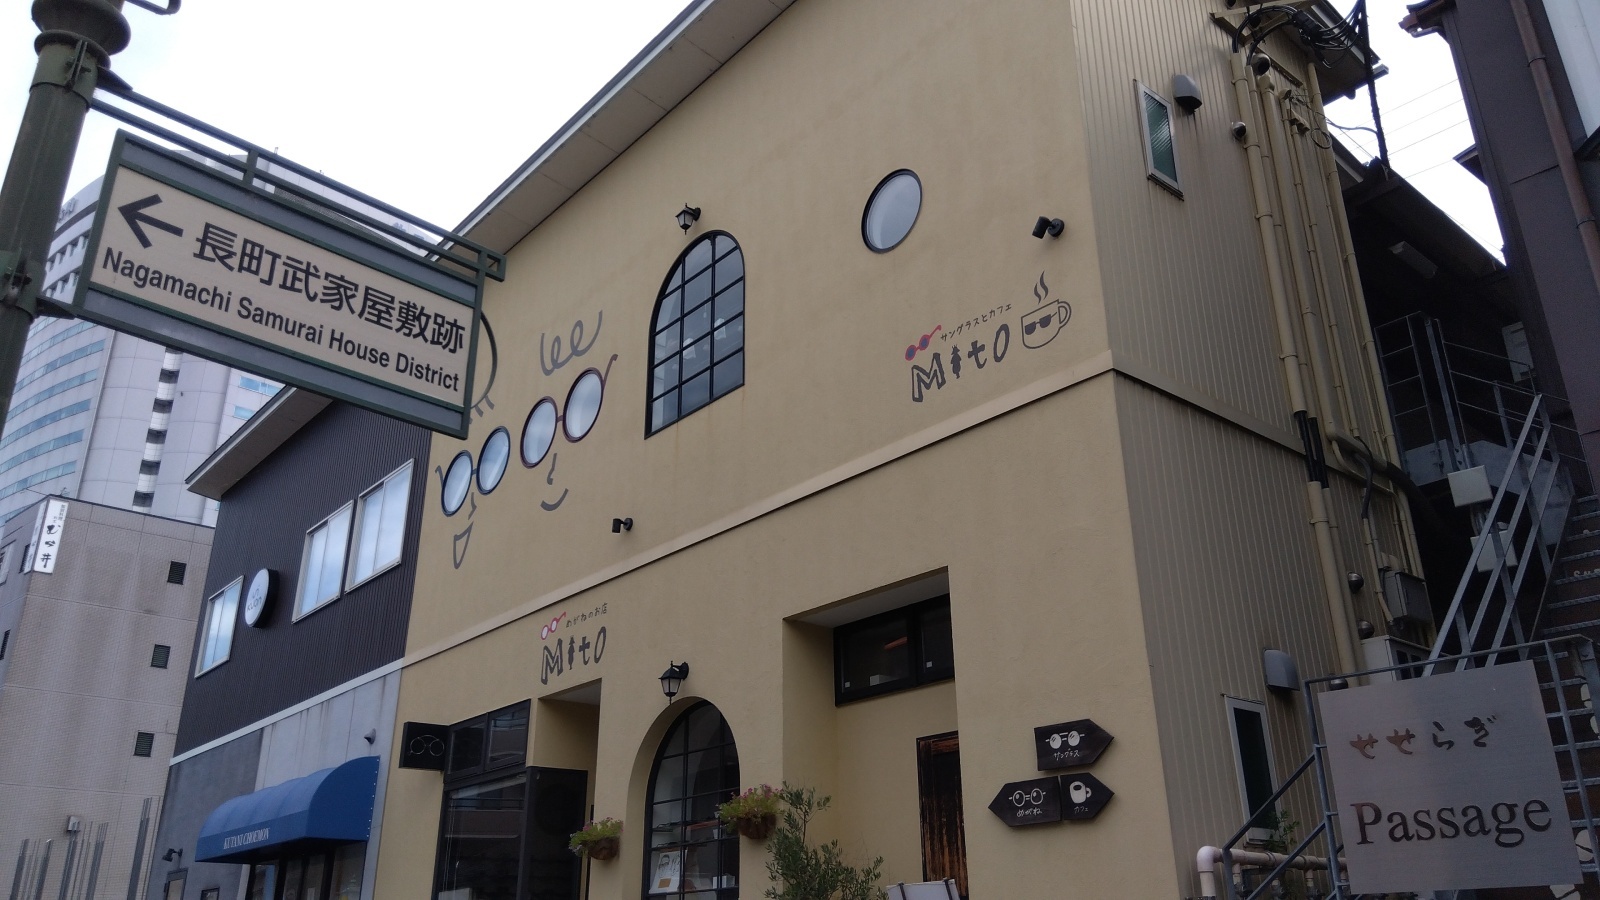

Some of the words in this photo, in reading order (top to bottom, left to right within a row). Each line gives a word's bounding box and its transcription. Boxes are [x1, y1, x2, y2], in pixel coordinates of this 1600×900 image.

[193, 221, 466, 354] 長町武家屋敷跡
[102, 246, 232, 313] Nagamachi
[237, 296, 324, 346] Samurai
[328, 327, 391, 368] House
[395, 351, 461, 393] District
[940, 303, 1013, 342] サングラスとカフェ
[565, 602, 608, 628] めがねのお店
[1053, 748, 1081, 761] サングラス
[1349, 715, 1497, 760] せせらぎ
[1016, 807, 1043, 818] めがね
[1073, 806, 1089, 815] カフェ
[1350, 798, 1553, 848] Passage
